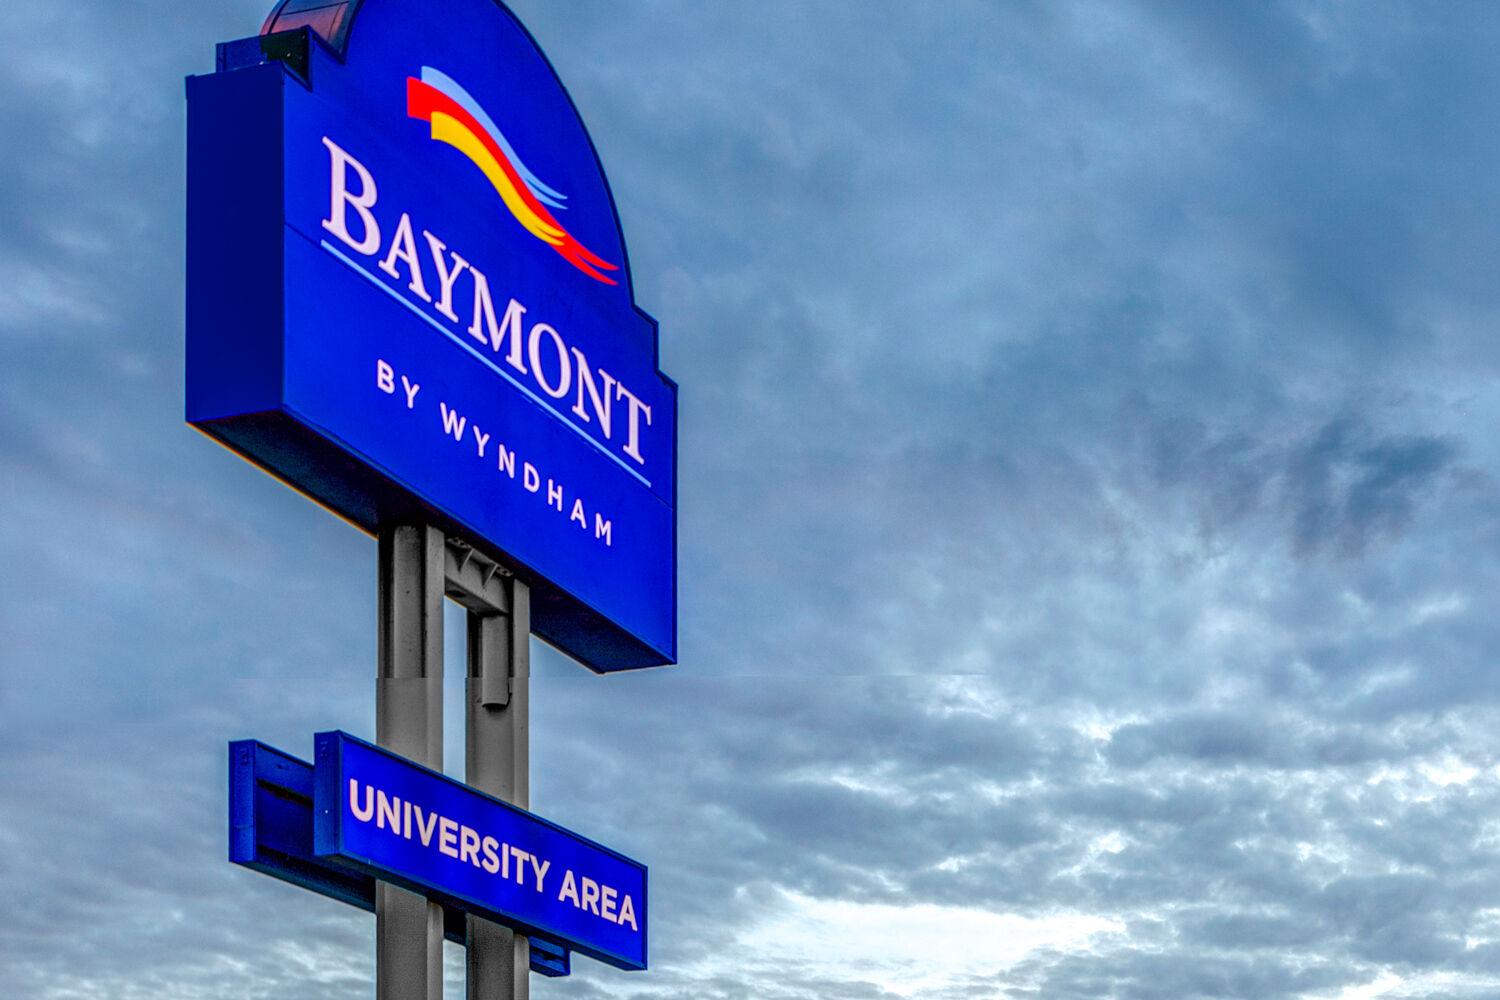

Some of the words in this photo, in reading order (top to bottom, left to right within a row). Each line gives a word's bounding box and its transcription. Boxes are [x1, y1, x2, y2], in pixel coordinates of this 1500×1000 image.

[322, 135, 652, 465] BAYMONT
[377, 358, 420, 409] BY
[439, 402, 612, 546] WYNDHAM
[350, 778, 551, 893] UNIVERSITY
[558, 869, 638, 931] AREA
